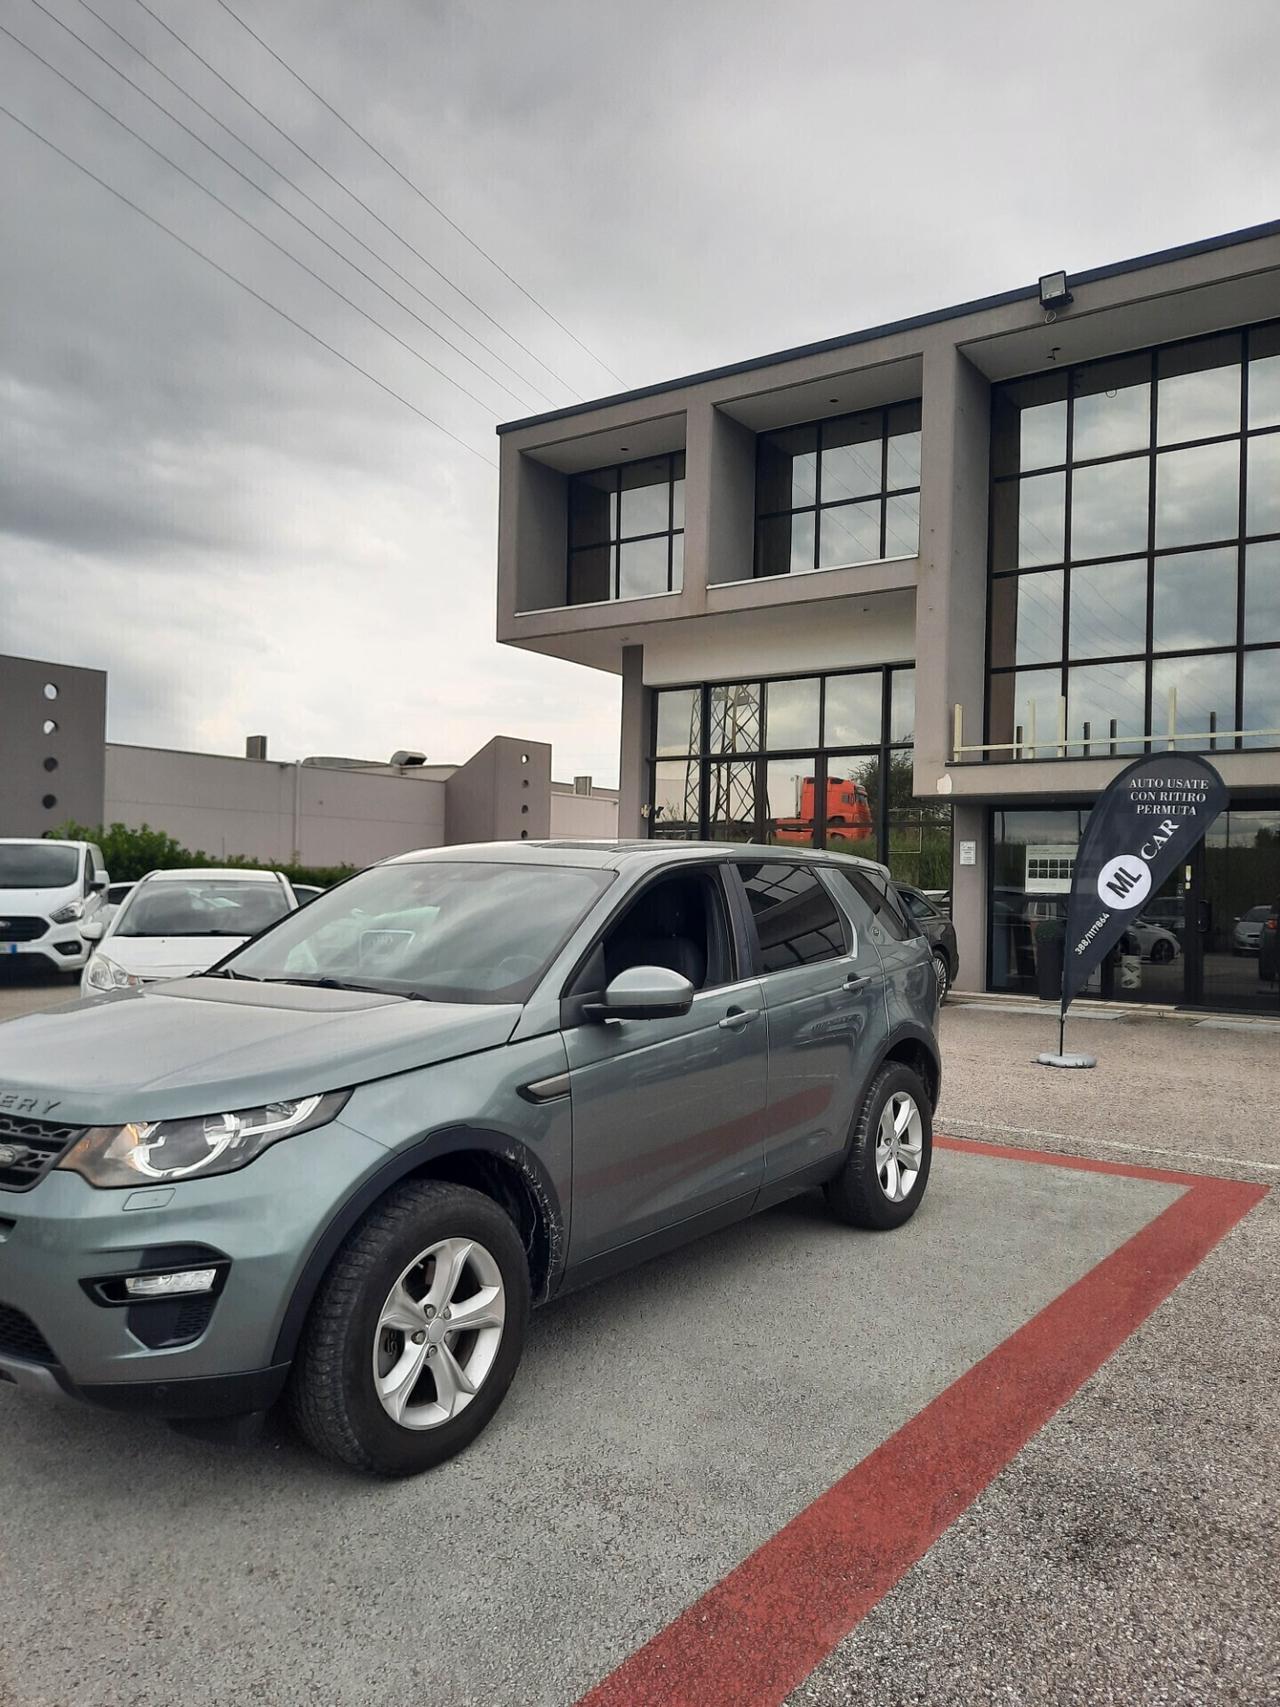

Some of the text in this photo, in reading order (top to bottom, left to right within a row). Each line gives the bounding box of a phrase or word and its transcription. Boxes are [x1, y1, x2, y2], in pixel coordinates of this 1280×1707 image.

[1128, 778, 1209, 790] AUTO USATE
[1130, 791, 1206, 802] CON RITIRO
[1136, 804, 1197, 816] PERMUTA
[1105, 819, 1180, 900] ML CAR
[1074, 912, 1110, 955] 388/1117864
[0, 1093, 61, 1115] ERY
